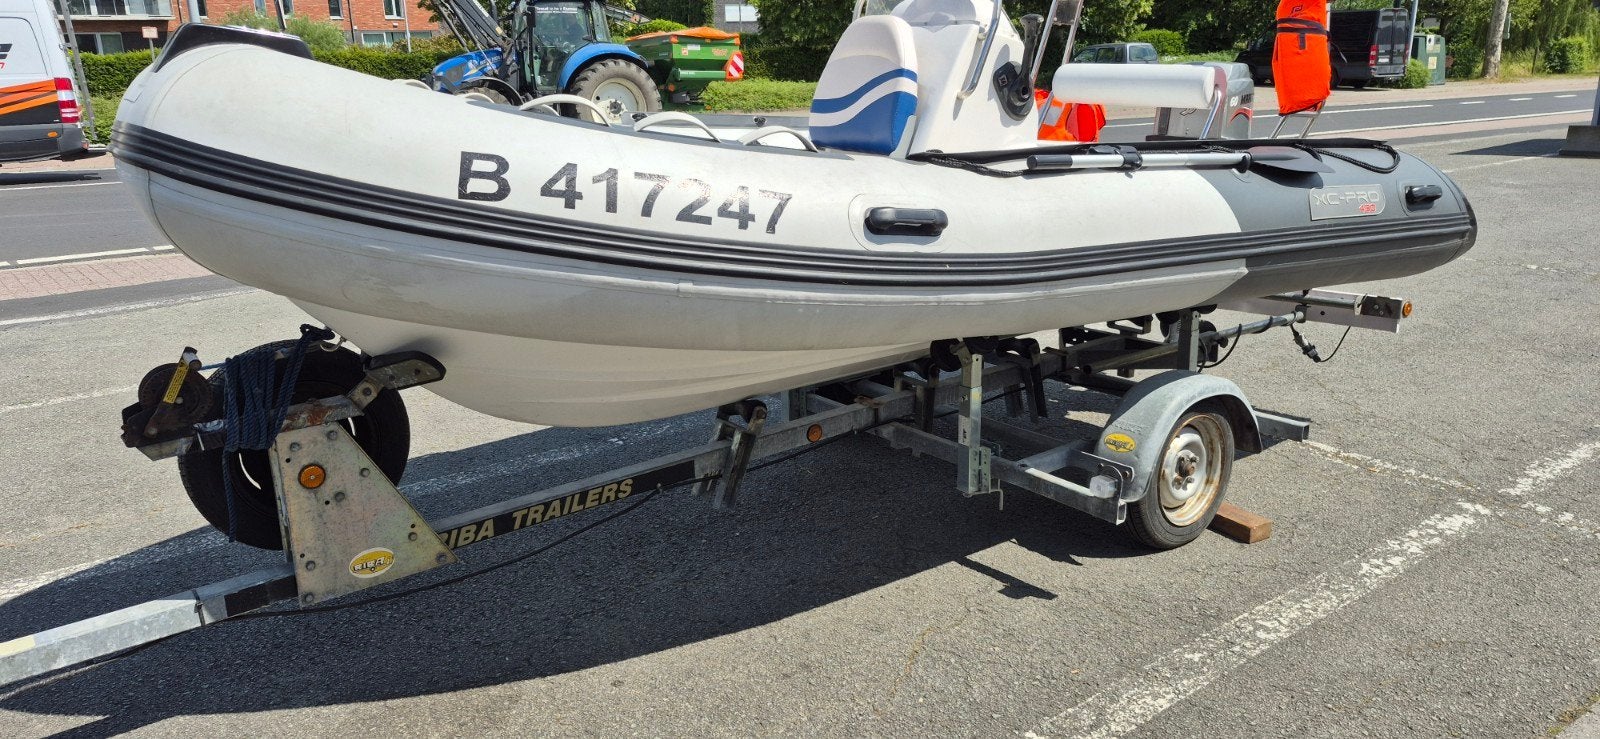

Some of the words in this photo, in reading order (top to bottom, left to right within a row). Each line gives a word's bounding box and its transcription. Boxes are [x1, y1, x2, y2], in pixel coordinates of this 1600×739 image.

[458, 151, 512, 202] B
[540, 162, 793, 235] 417247
[1312, 190, 1380, 206] XC-PRO
[511, 478, 634, 531] TRAILERS
